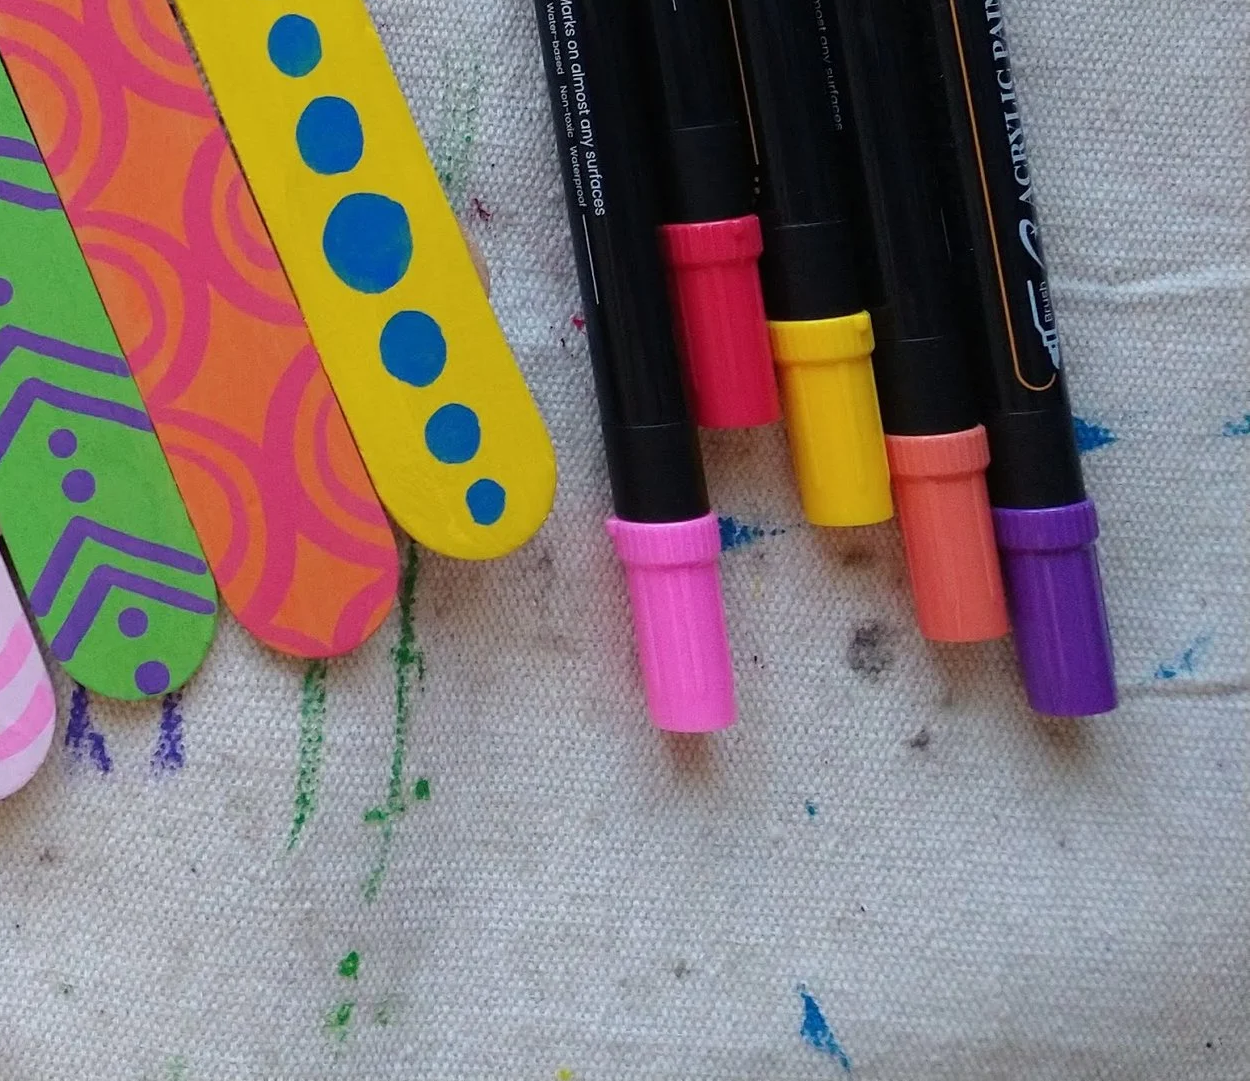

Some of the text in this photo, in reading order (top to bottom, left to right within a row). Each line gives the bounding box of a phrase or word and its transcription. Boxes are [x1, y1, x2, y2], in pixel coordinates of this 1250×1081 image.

[567, 41, 580, 60] on
[546, 2, 587, 208] Water-based Non-toxic Waterproof
[571, 63, 591, 115] almost
[579, 119, 594, 148] any
[996, 69, 1033, 207] ACRYLIC
[586, 151, 607, 217] surfaces
[1039, 280, 1054, 323] Brush
